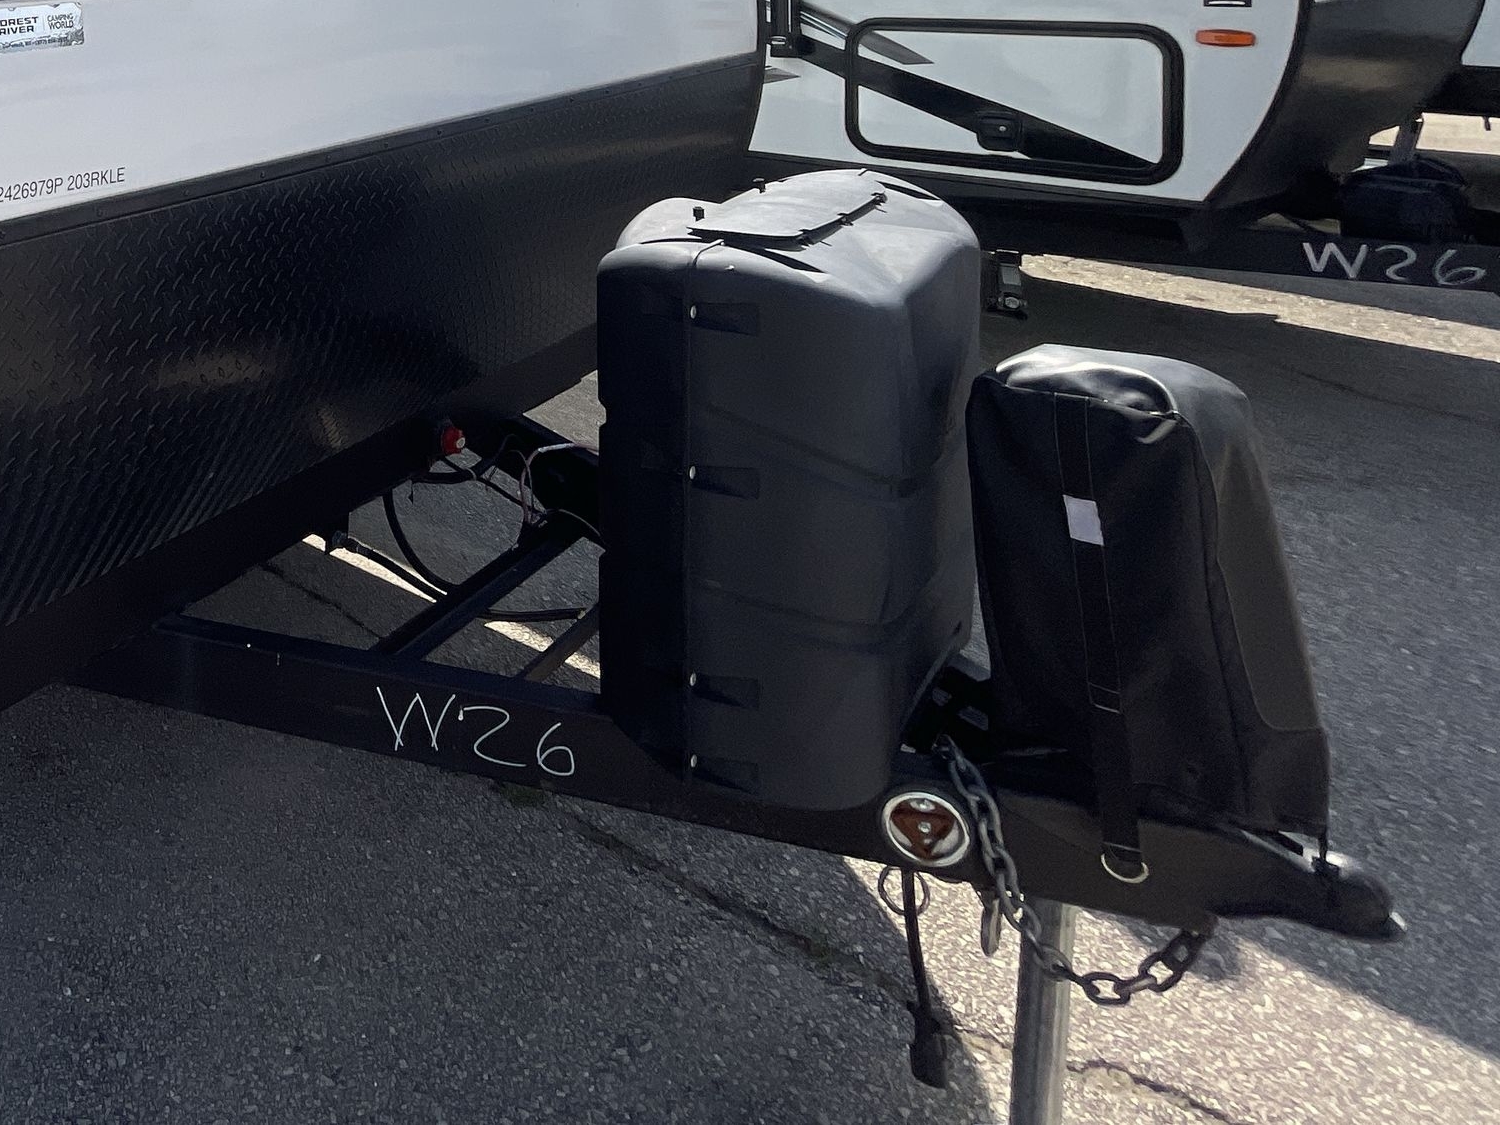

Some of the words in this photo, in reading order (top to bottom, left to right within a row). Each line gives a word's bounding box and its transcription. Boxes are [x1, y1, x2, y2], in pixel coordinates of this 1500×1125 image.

[47, 13, 74, 22] CAMPING
[47, 20, 75, 30] WORLD
[67, 167, 126, 191] 203RKLE
[1301, 242, 1487, 286] W26
[376, 686, 576, 776] W26
